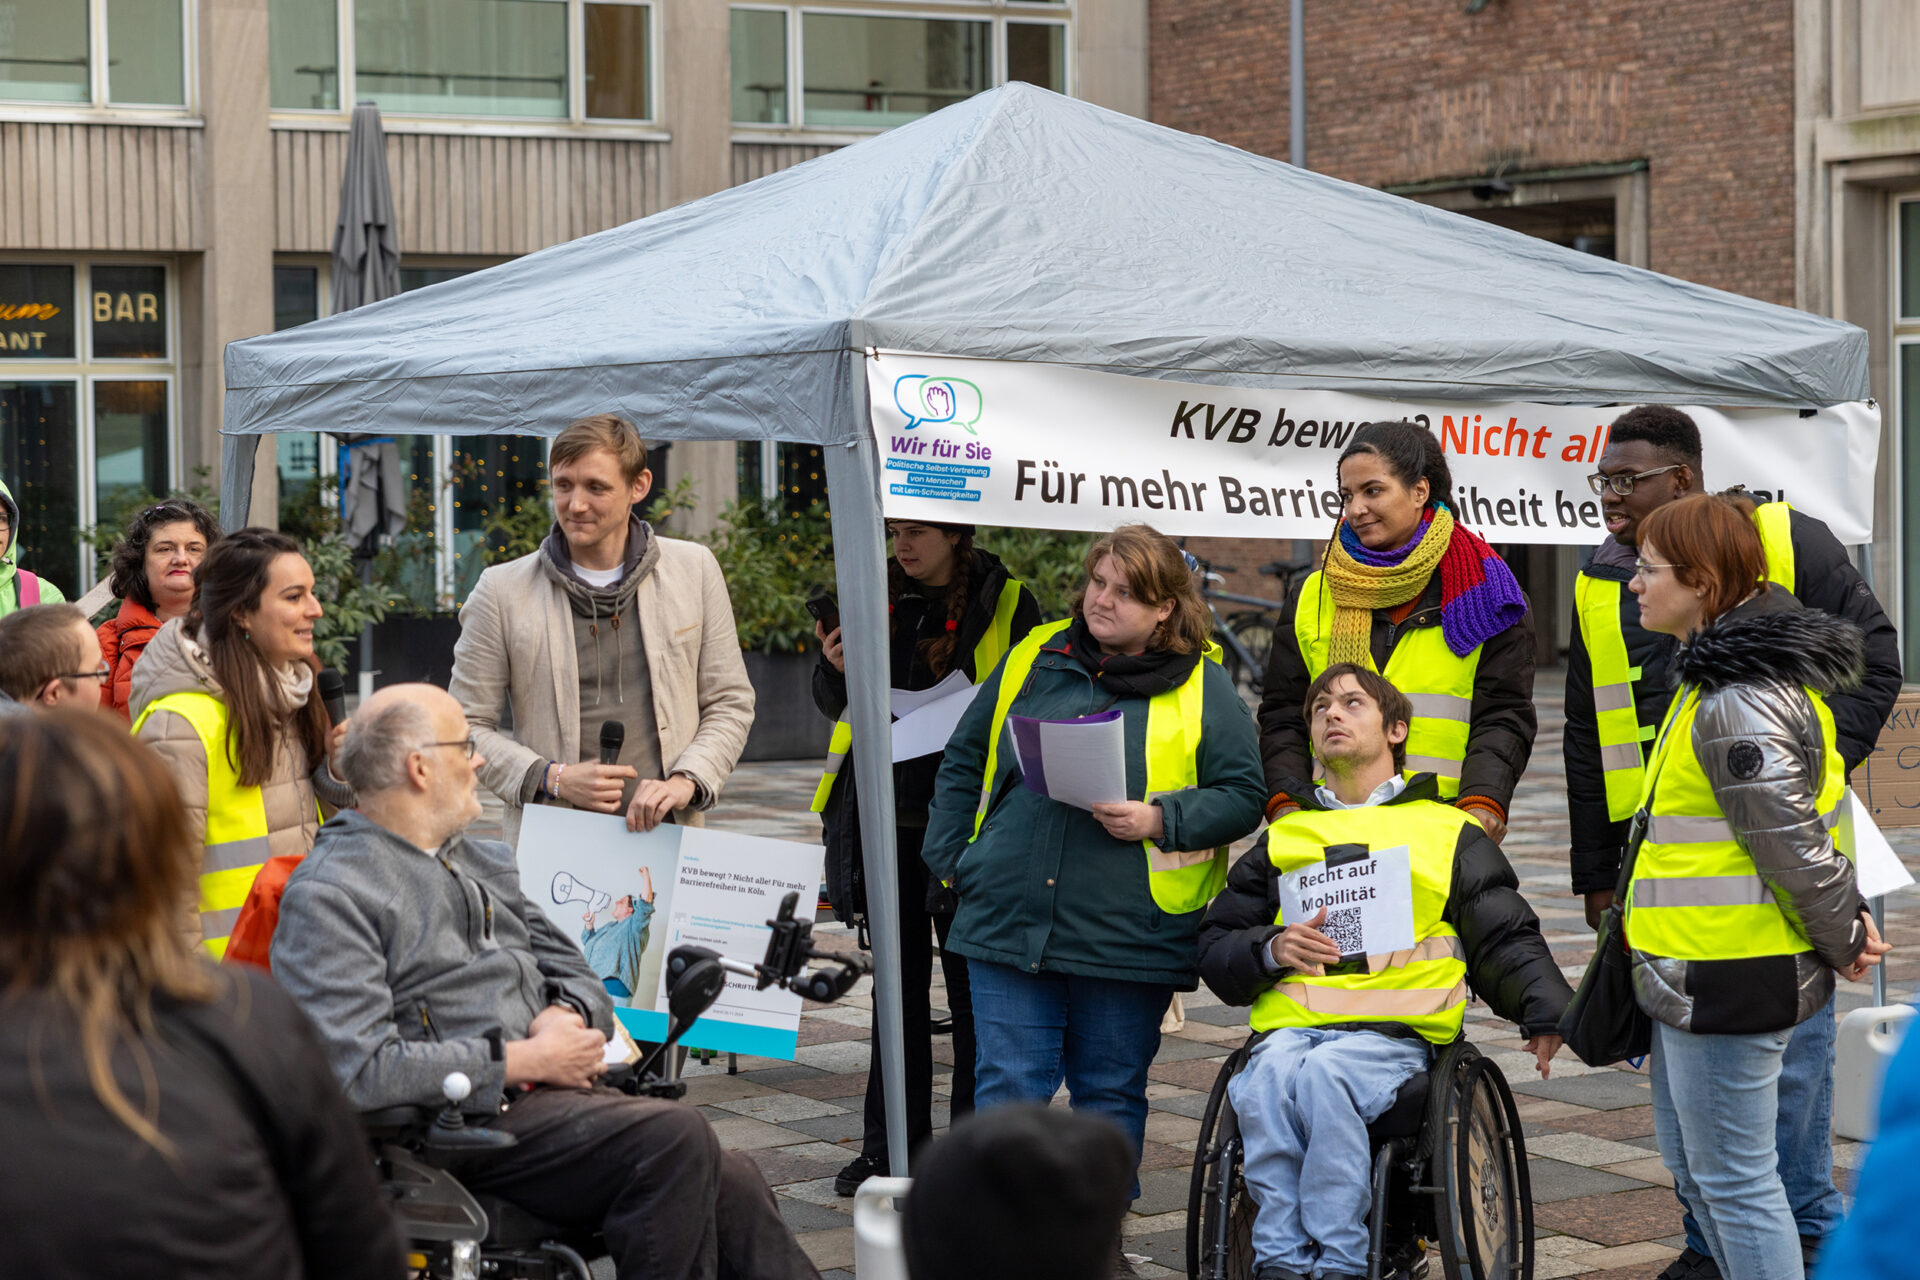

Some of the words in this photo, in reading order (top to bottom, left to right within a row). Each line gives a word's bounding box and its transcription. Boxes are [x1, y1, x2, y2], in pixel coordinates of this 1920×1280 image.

[94, 292, 158, 323] BAR
[1170, 400, 1262, 443] KVB
[891, 436, 927, 455] Wir
[932, 439, 961, 458] für
[965, 441, 992, 460] Sie
[1441, 414, 1552, 458] Nicht
[887, 459, 925, 470] Politische
[891, 486, 903, 494] mit
[925, 477, 964, 486] Menschen
[1015, 459, 1086, 504] Für
[1100, 469, 1207, 512] mehr
[680, 877, 737, 892] Barrierefreiheit
[681, 866, 699, 875] KVB
[699, 868, 726, 880] bewegt
[733, 873, 754, 883] Nicht
[755, 877, 771, 886] alle!
[772, 879, 785, 888] Für
[786, 882, 806, 891] mehr
[1300, 867, 1343, 890] Recht
[1348, 860, 1377, 878] auf
[1302, 886, 1376, 913] Mobilität
